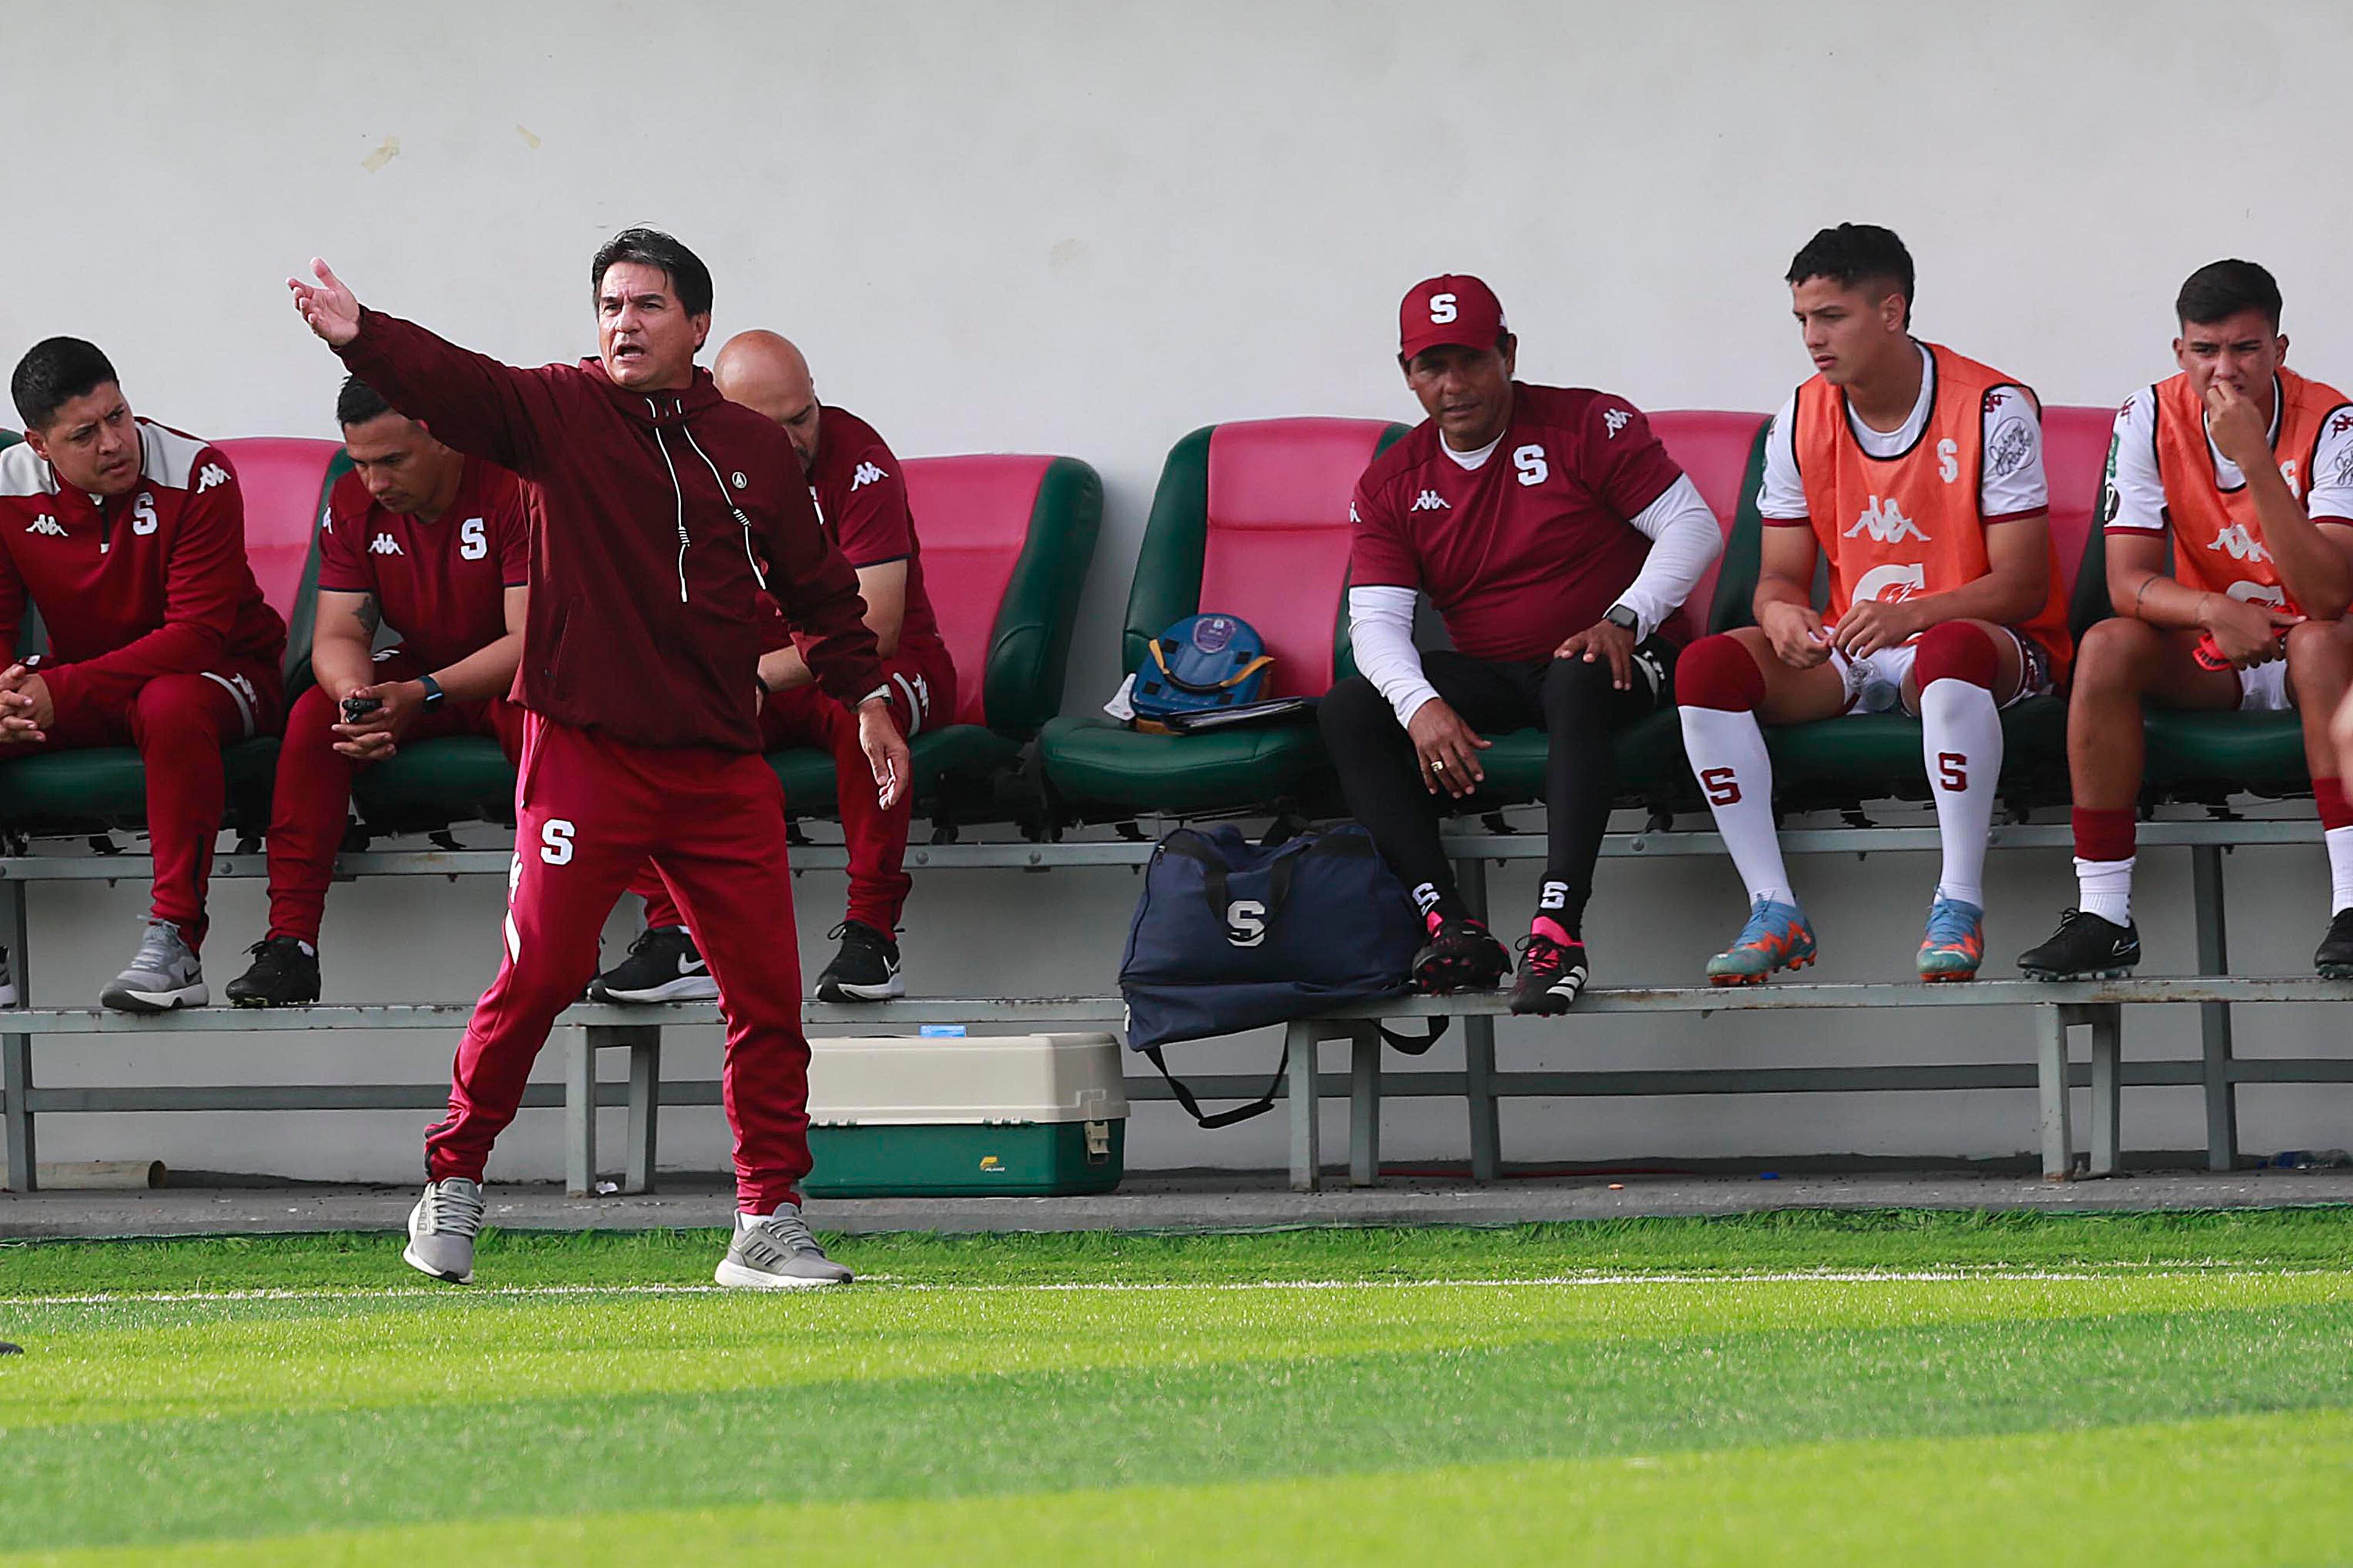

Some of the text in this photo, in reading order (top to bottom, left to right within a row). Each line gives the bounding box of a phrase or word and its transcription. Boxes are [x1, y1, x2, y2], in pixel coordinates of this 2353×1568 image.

[1430, 293, 1457, 324] S
[1513, 444, 1548, 486] S
[1937, 438, 1958, 483] S
[133, 492, 158, 535] S
[461, 518, 487, 560] S
[1700, 767, 1742, 806] S
[1938, 752, 1968, 792] S
[540, 819, 575, 865] S
[1412, 882, 1441, 917] S
[1540, 881, 1568, 909] S
[1227, 900, 1266, 947] S
